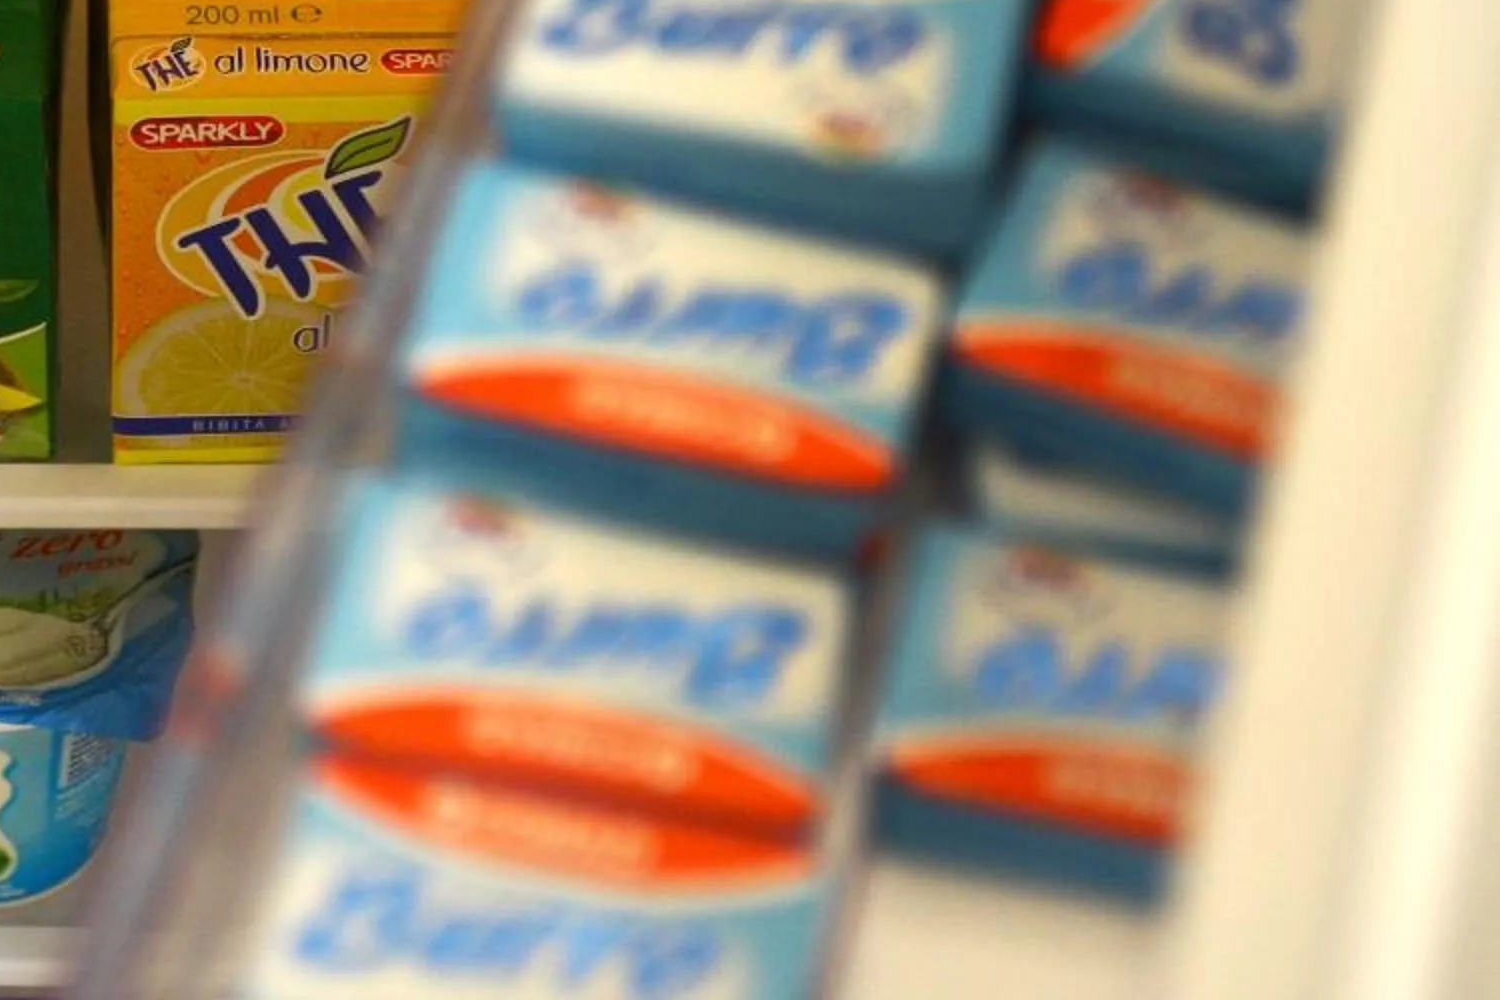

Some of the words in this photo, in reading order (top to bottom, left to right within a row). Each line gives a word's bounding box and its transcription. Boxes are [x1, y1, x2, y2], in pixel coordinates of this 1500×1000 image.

[186, 5, 239, 25] 200
[249, 5, 279, 24] ml
[135, 50, 200, 91] THE
[214, 46, 244, 74] al
[256, 46, 369, 73] limone
[389, 52, 452, 69] SPAR
[140, 120, 274, 144] SPARKLY
[293, 314, 332, 352] al
[192, 418, 267, 433] BIBITA
[10, 530, 124, 559] zero
